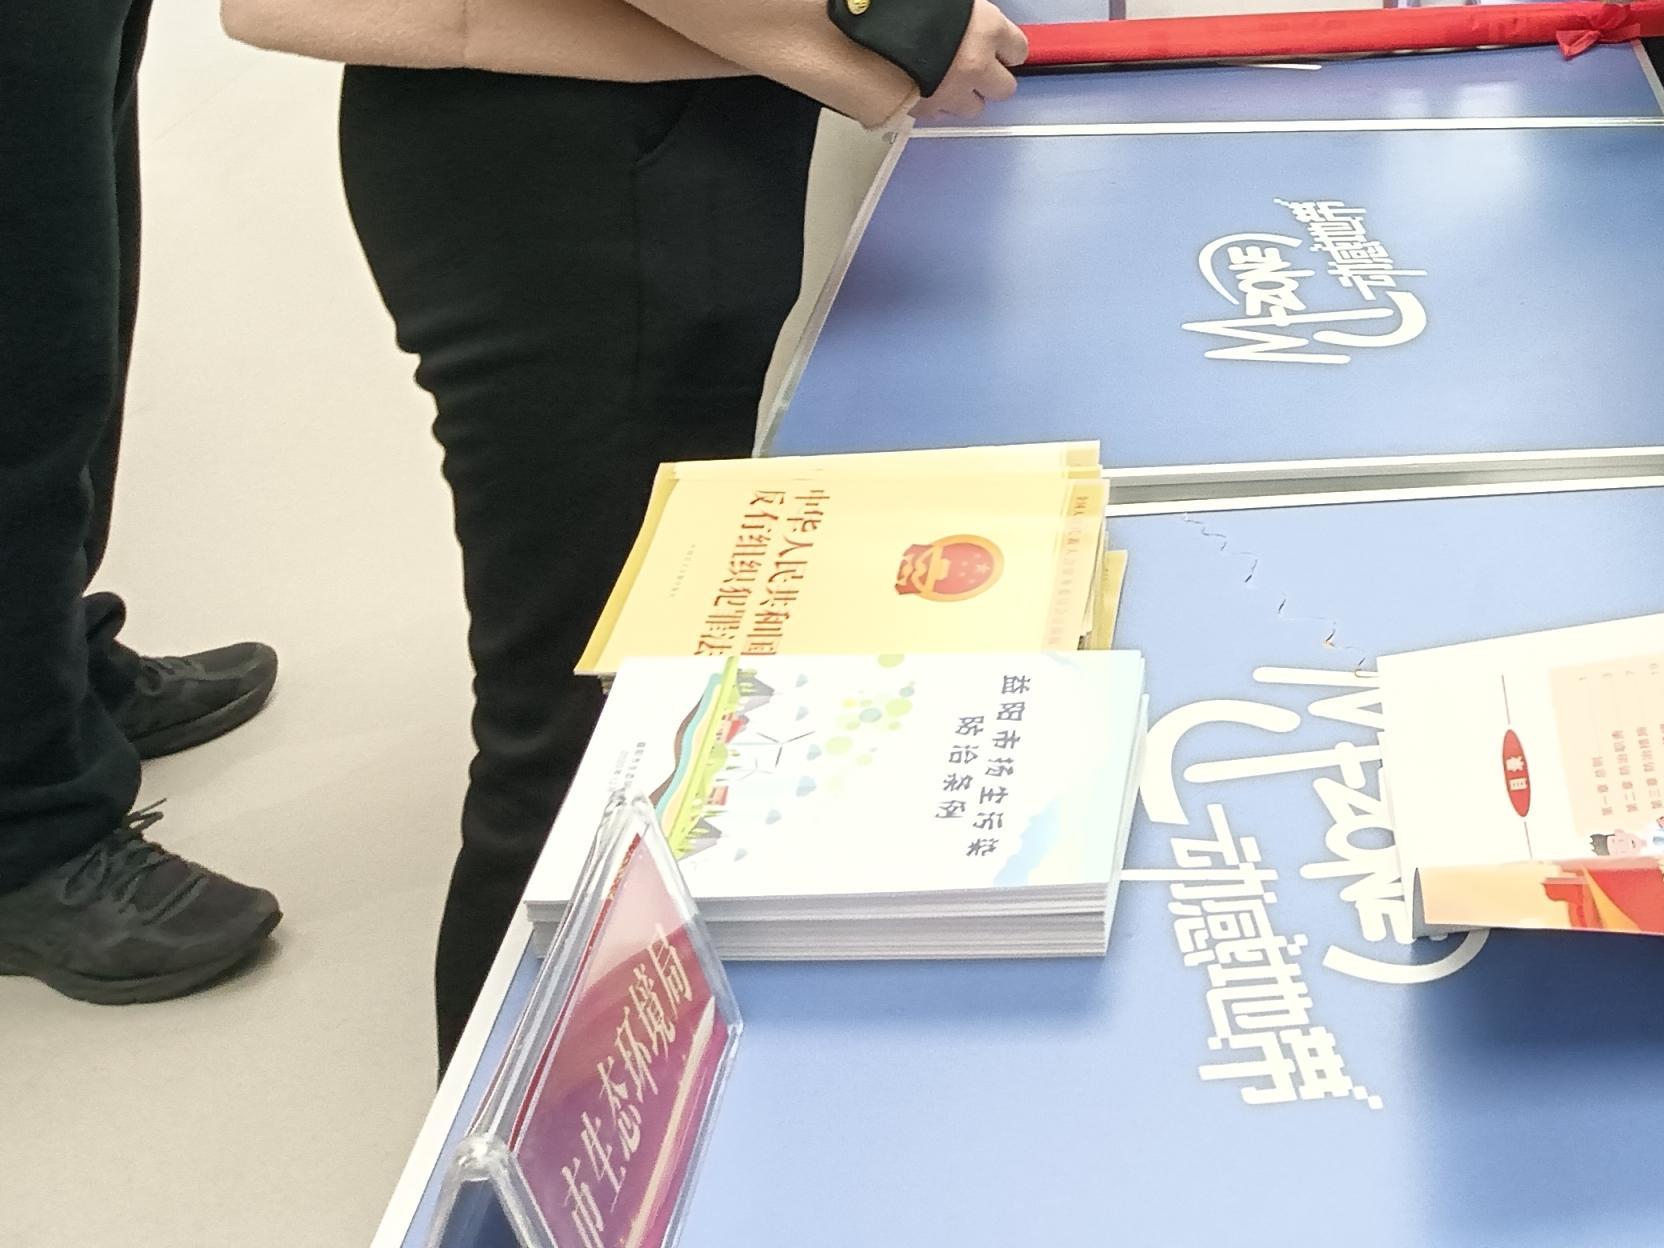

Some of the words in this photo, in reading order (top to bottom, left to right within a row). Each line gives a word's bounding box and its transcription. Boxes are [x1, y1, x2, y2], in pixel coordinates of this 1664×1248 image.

[1273, 197, 1428, 301] 动感地带
[740, 489, 831, 656] 中华人民共和国
[935, 715, 985, 820] 防治条例
[967, 674, 1031, 858] 益阳市扬尘污染
[1121, 803, 1383, 1110] 动感地带
[561, 923, 693, 1248] 市生态环境局
